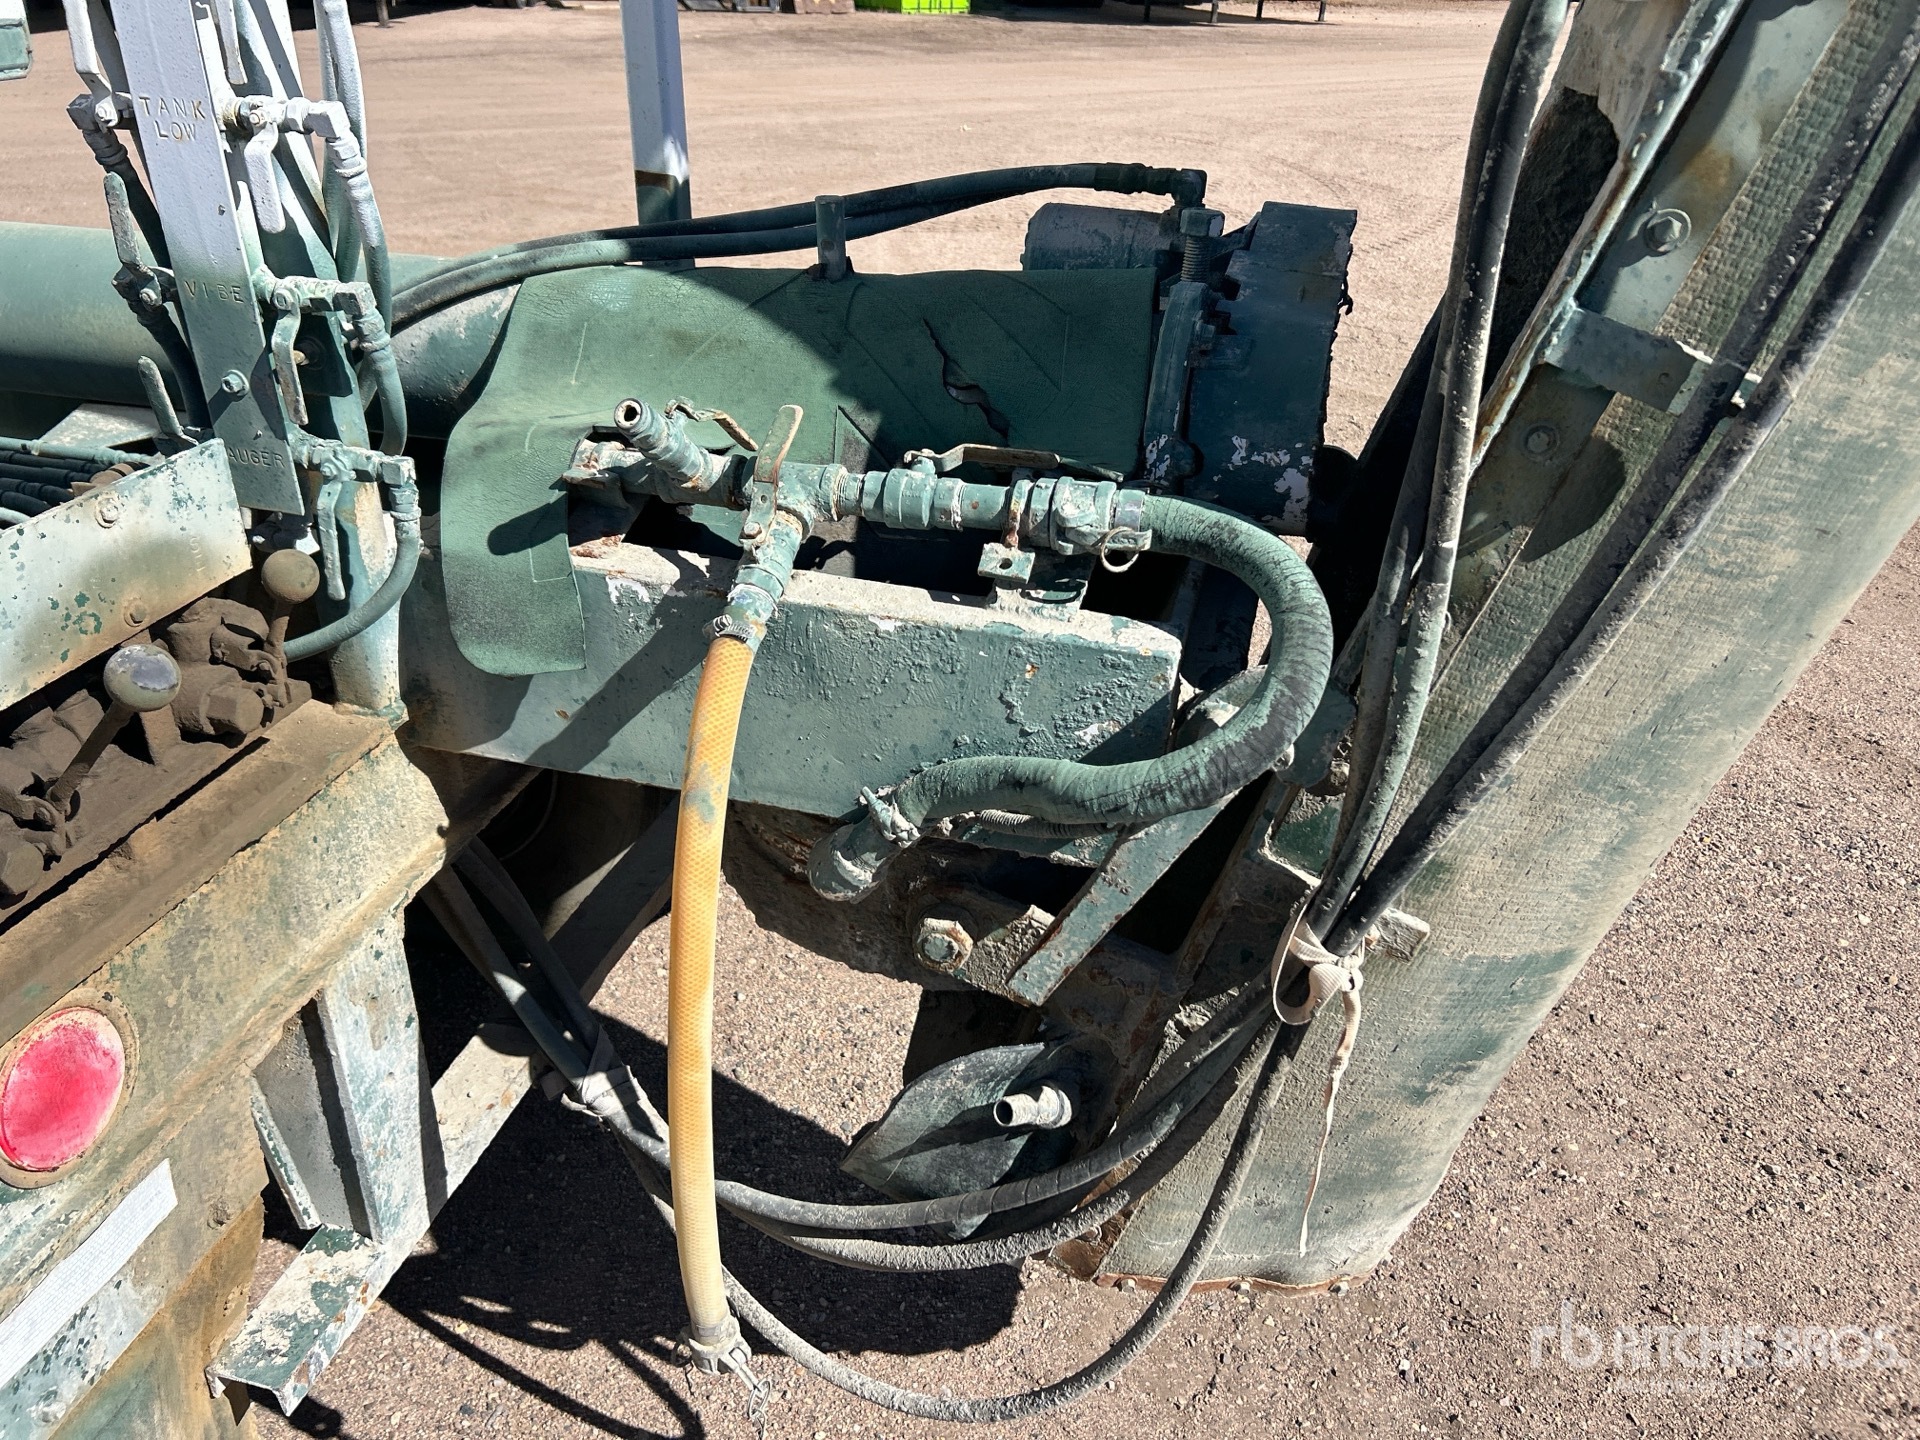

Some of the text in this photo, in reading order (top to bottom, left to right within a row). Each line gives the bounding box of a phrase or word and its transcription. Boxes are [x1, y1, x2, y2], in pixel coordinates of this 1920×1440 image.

[138, 96, 206, 120] TANK
[153, 119, 197, 141] LOW
[183, 280, 245, 304] VIBE
[227, 446, 286, 469] AUGER
